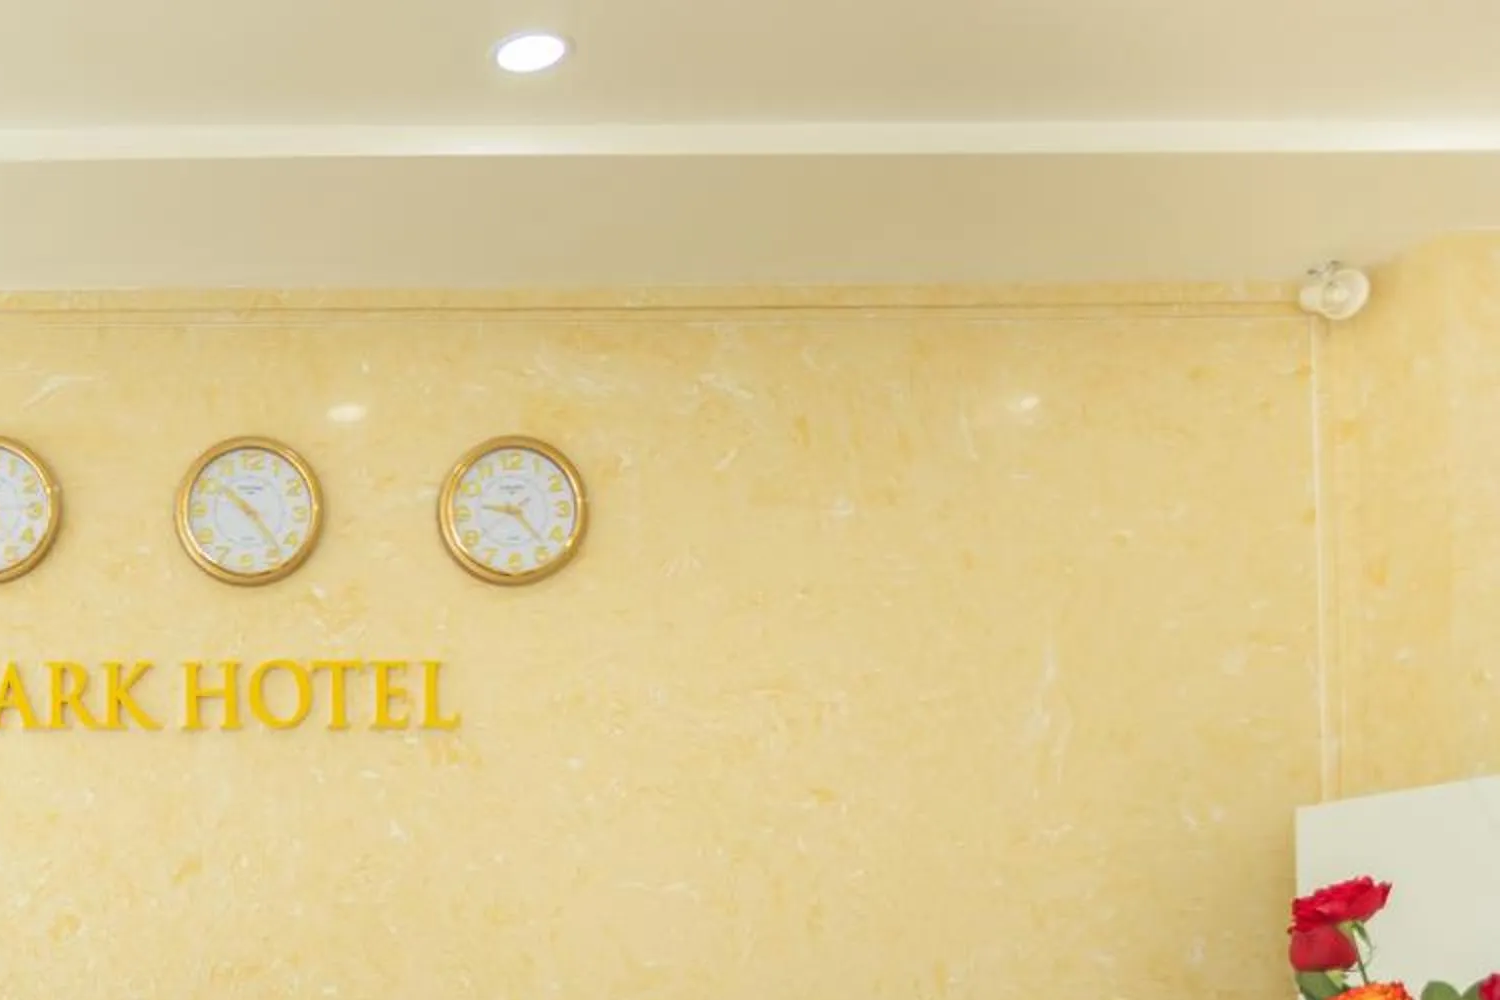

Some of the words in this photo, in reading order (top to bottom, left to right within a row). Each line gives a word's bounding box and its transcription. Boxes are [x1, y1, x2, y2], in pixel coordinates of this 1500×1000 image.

[240, 451, 264, 470] 12
[498, 451, 524, 471] 12
[284, 478, 302, 497] 2
[554, 498, 572, 519] 3
[214, 544, 232, 566] 7
[180, 659, 462, 732] HOTEL
